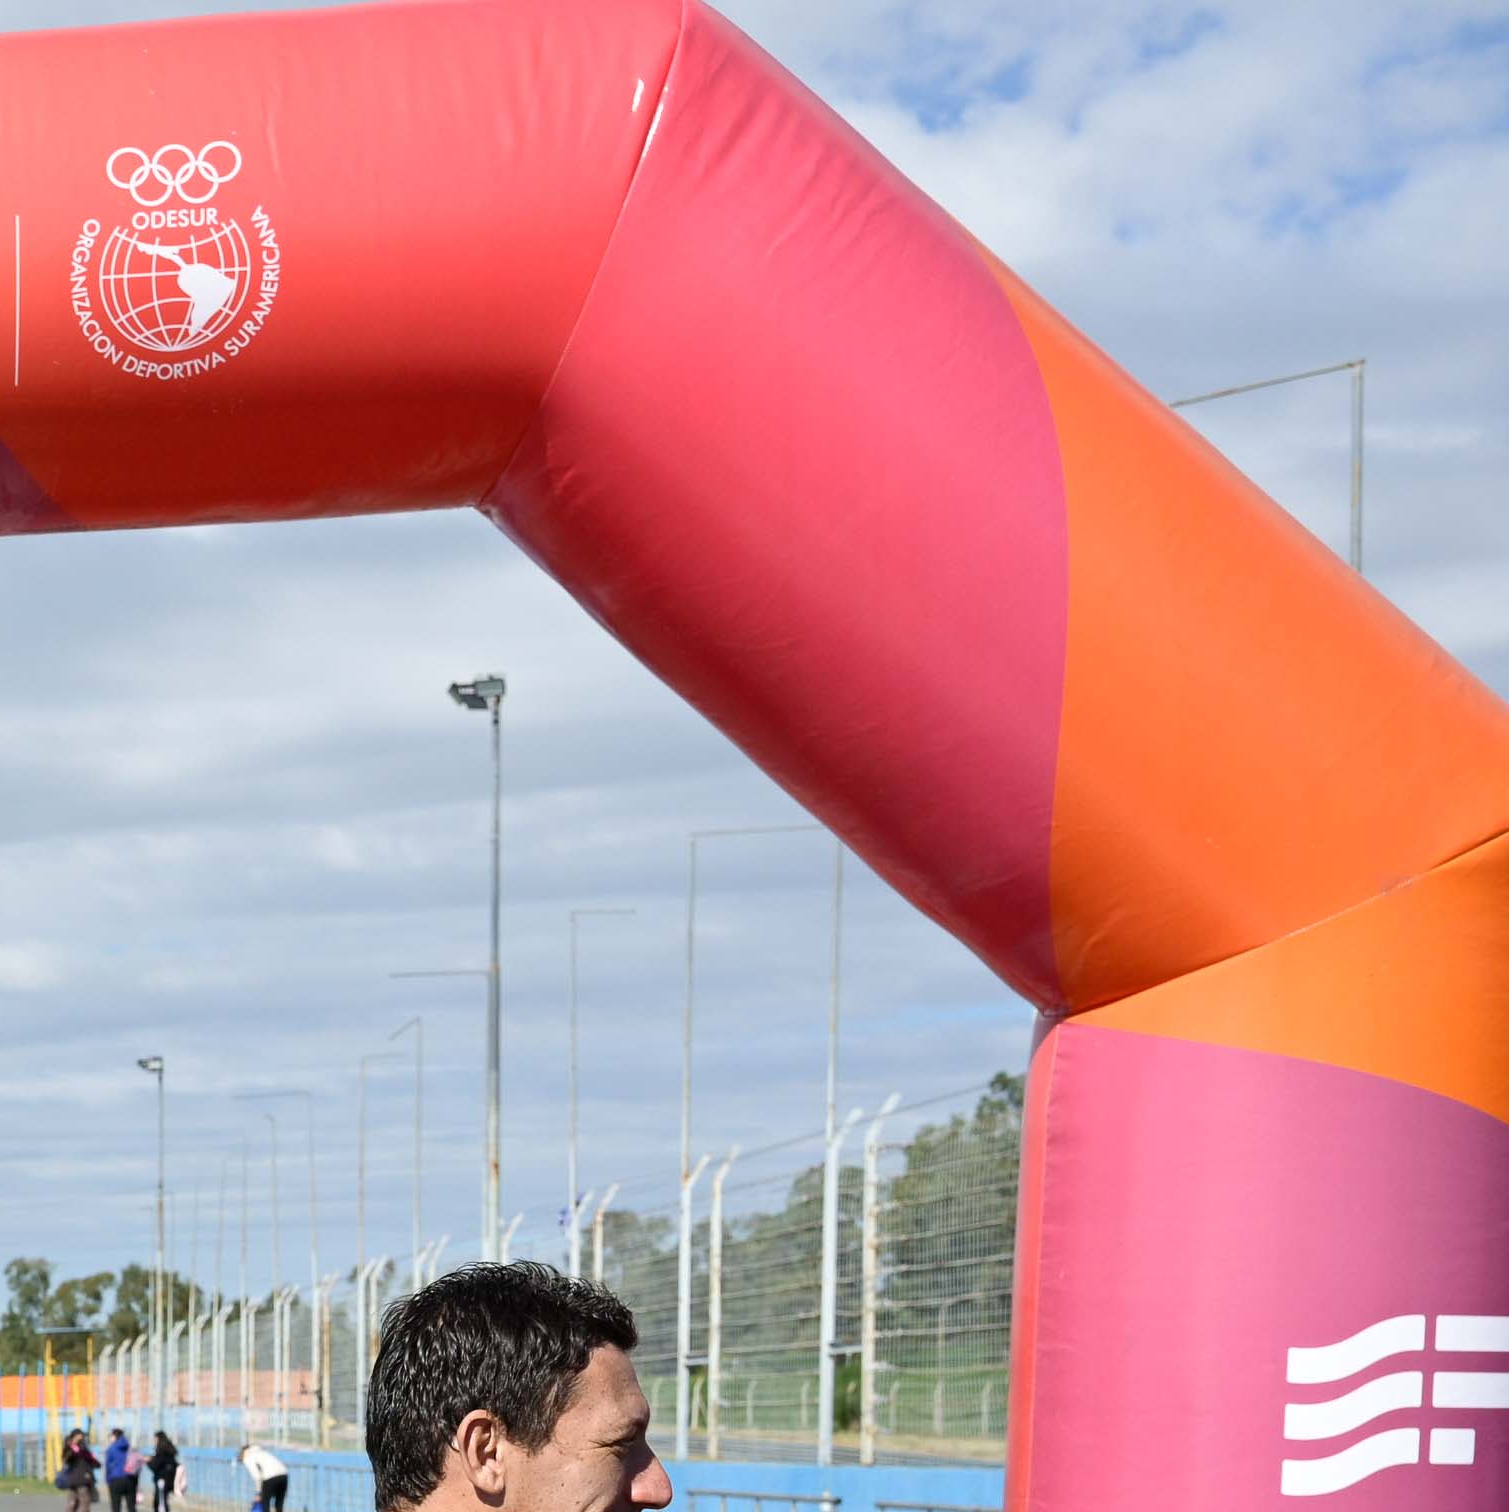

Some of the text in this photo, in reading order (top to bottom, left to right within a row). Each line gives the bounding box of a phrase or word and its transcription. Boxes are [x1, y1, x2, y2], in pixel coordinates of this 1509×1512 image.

[131, 207, 218, 230] ODESUR
[70, 206, 281, 380] ORGANIZACION DEPORTIVA SURAMERICANA
